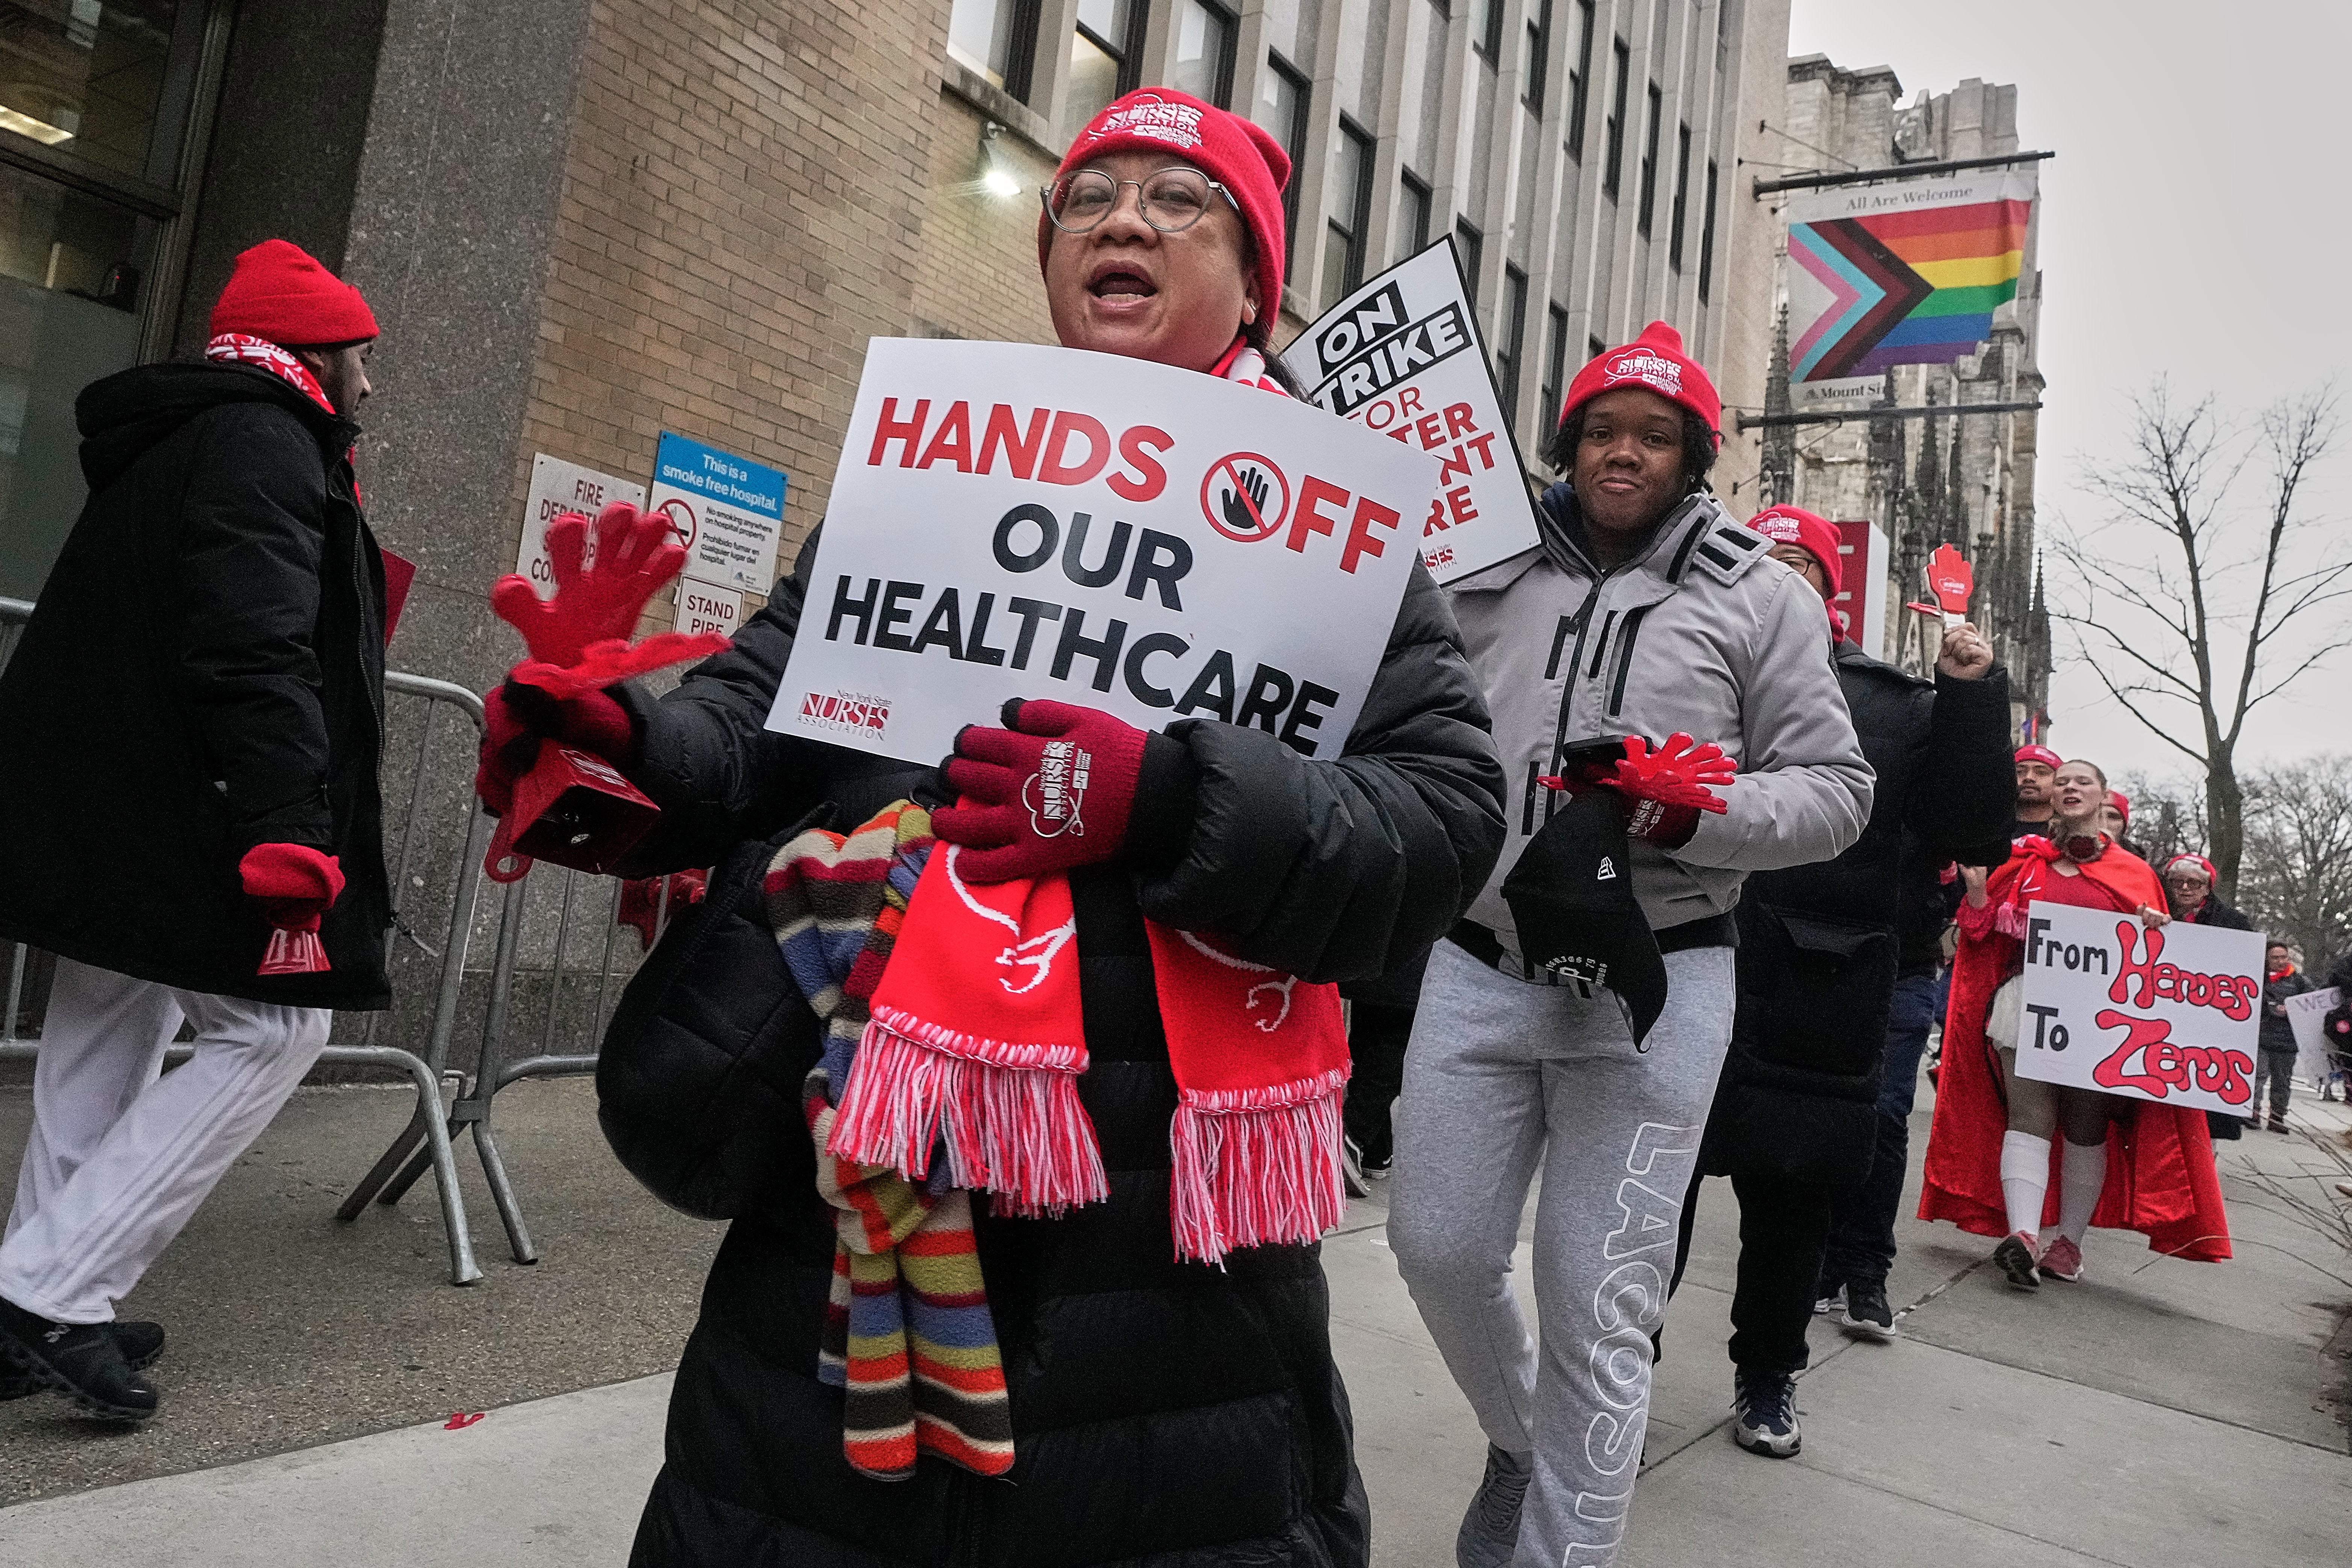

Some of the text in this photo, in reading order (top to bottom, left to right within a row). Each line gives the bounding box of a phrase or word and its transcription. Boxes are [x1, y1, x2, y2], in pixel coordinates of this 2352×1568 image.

[1846, 188, 1974, 211] All Are Welcome
[1322, 292, 1397, 364] ON
[1314, 309, 1465, 415] TRIKE
[1618, 358, 1682, 377] NURSES
[1821, 384, 1865, 398] Mount
[1349, 386, 1425, 430] OR
[1386, 402, 1479, 451] TER
[867, 397, 1175, 503] HANDS
[663, 465, 704, 487] smoke
[705, 475, 730, 495] free
[703, 453, 748, 482] This is a
[574, 479, 604, 507] FIRE
[706, 505, 773, 534] No smoking anywhere
[1423, 485, 1479, 537] RE
[714, 519, 739, 533] hospital
[701, 544, 757, 564] cualquier lugar del
[702, 531, 733, 548] Prohibido
[733, 541, 752, 553] fumar
[993, 502, 1194, 612] OUR
[1425, 548, 1453, 567] SES
[687, 594, 734, 620] STAND
[825, 575, 1340, 758] HEALTHCARE
[798, 692, 890, 731] NURSES
[837, 689, 893, 708] New York State
[795, 714, 885, 742] ASSOCIATION
[1043, 741, 1067, 819] NURSES
[2026, 917, 2258, 1021] From Heroes
[2026, 1003, 2255, 1105] To Zeros
